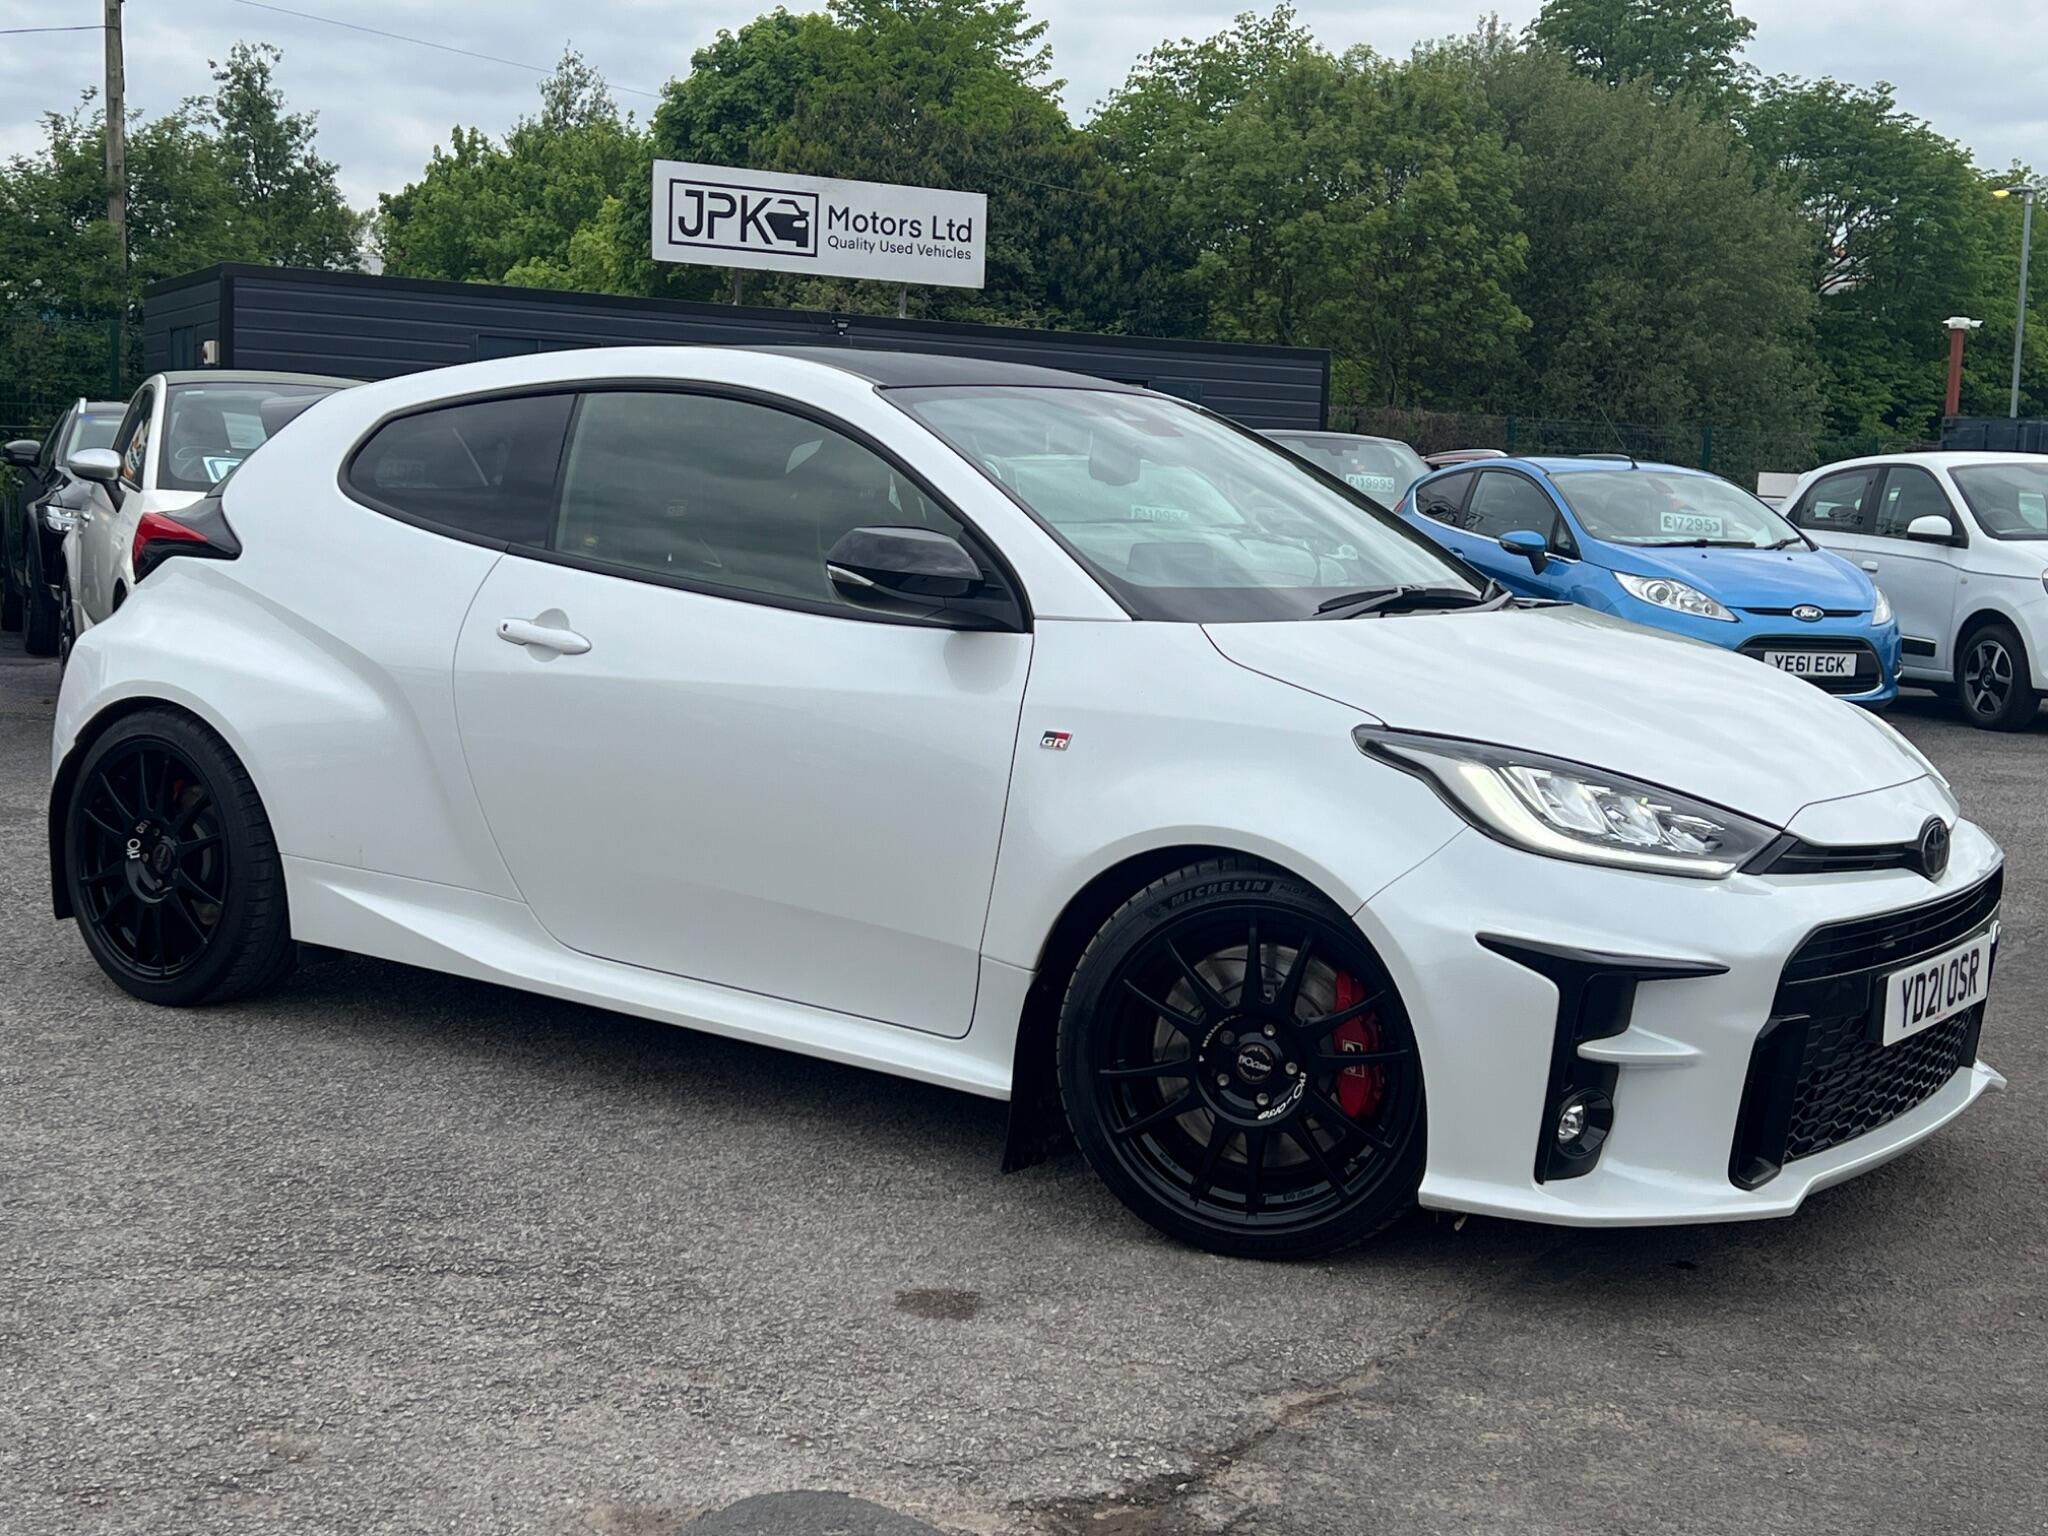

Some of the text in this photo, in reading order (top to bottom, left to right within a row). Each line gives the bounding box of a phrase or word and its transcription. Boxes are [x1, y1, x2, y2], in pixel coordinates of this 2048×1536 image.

[678, 189, 774, 245] JPK
[828, 205, 972, 243] Motors Ltd
[827, 235, 972, 260] Quality Used Vehicles
[1800, 608, 1818, 617] Ford
[1774, 655, 1847, 673] YE61 EGK
[1042, 737, 1067, 748] GR
[1171, 880, 1267, 906] MICHELIN
[1902, 948, 1980, 1028] YD21 OSR
